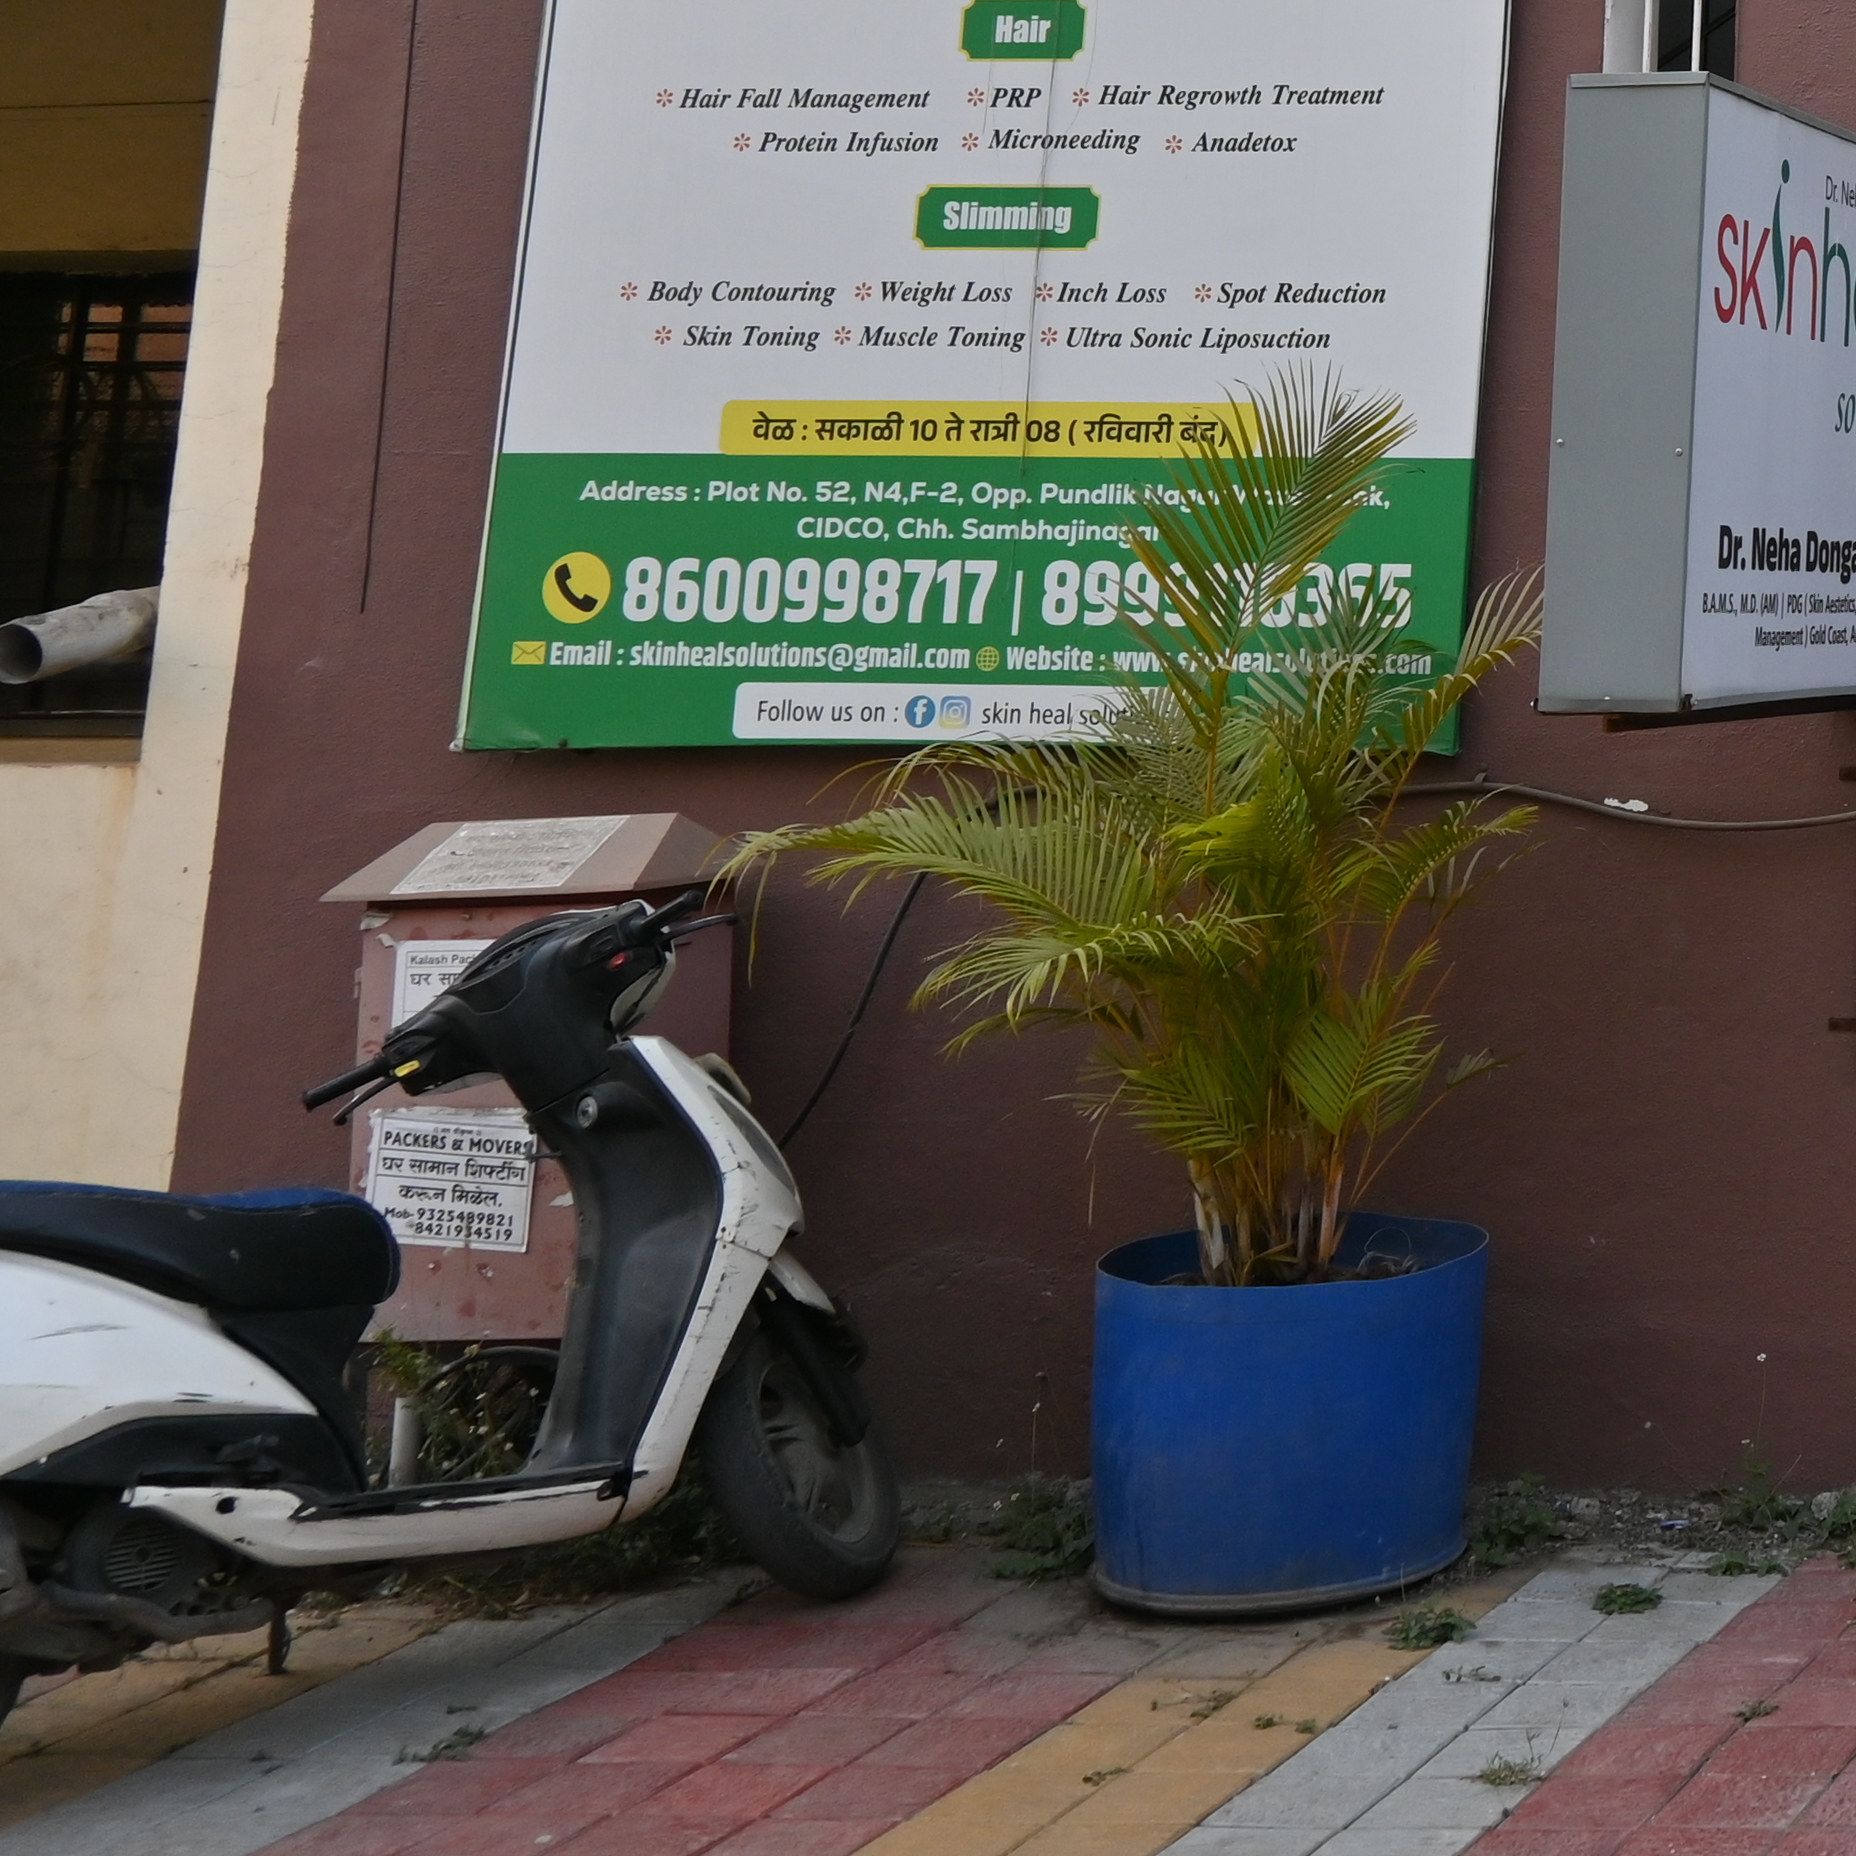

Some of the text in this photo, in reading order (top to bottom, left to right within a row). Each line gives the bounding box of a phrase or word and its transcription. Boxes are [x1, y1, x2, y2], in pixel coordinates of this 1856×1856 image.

[994, 15, 1051, 44] Hair
[679, 87, 930, 113] Hair Fall Management
[990, 87, 1042, 108] PRP
[1098, 84, 1385, 110] Hair Regrowth Treatment
[758, 131, 939, 157] Protein Infusion
[988, 129, 1141, 155] Microneeding
[1191, 132, 1297, 153] Anadetox
[943, 200, 1072, 234] Slimming
[647, 281, 837, 307] Body Contouring
[880, 281, 1013, 308] Weight Loss
[1057, 282, 1167, 303] Inch Loss
[1216, 282, 1387, 308] Spot Reduction
[683, 325, 821, 352] Skin Toning
[858, 326, 1026, 352] Muscle Toning
[1065, 326, 1331, 355] Ultra Sonic Liposuction
[814, 411, 1172, 444] सकाळी 10 रविवारी
[579, 480, 688, 501] Address
[708, 481, 760, 501] Plot
[767, 482, 808, 502] No.
[815, 482, 857, 505] 52,
[971, 483, 1032, 510] Opp.
[1040, 483, 1135, 506] Pundlik
[797, 517, 890, 541] CIDCO,
[897, 517, 954, 540] Chh.
[1718, 525, 1746, 571] Dr.
[1751, 527, 1801, 572] Neha
[622, 556, 998, 625] 8600998717
[549, 642, 971, 673] Email skinhealsolutions@gmail.com
[1006, 646, 1092, 672] Website
[757, 701, 1021, 724] Follow us skin
[384, 1131, 446, 1150] PACKERS
[409, 1159, 460, 1176] सामान
